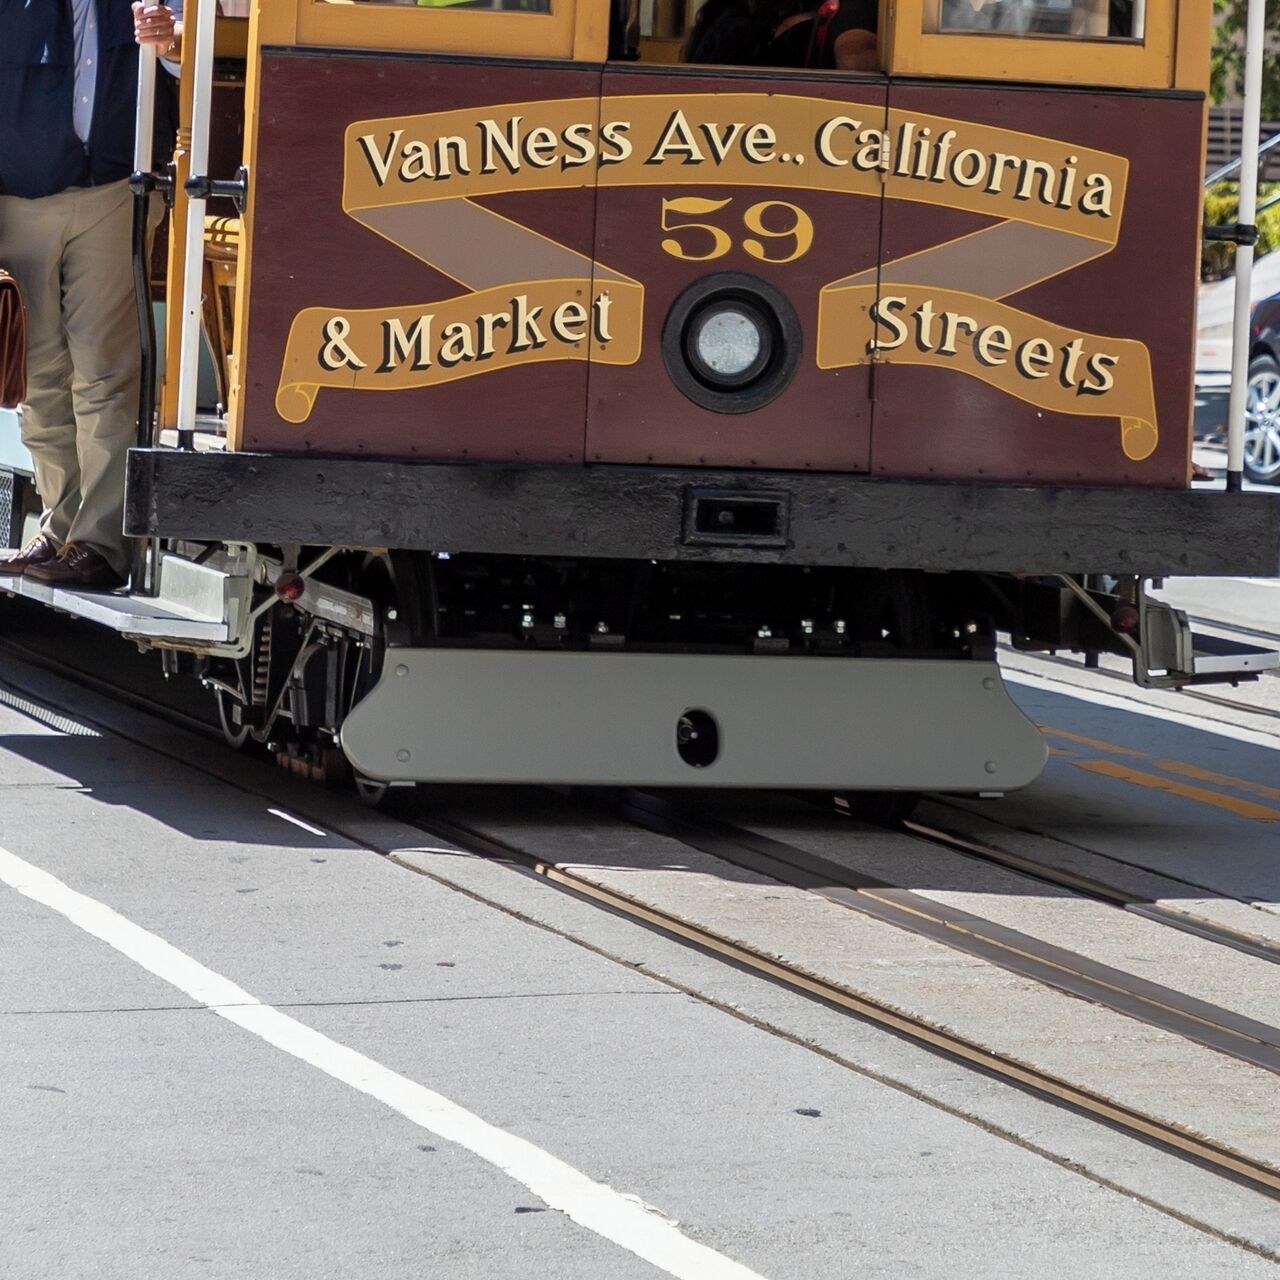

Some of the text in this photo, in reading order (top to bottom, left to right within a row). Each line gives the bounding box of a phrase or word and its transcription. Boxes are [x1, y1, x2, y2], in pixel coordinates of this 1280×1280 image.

[357, 129, 471, 188] Van
[476, 116, 634, 176] Ness
[814, 116, 1113, 218] California
[661, 196, 814, 264] 59
[318, 292, 613, 374] & Market
[866, 296, 1120, 396] Streets
